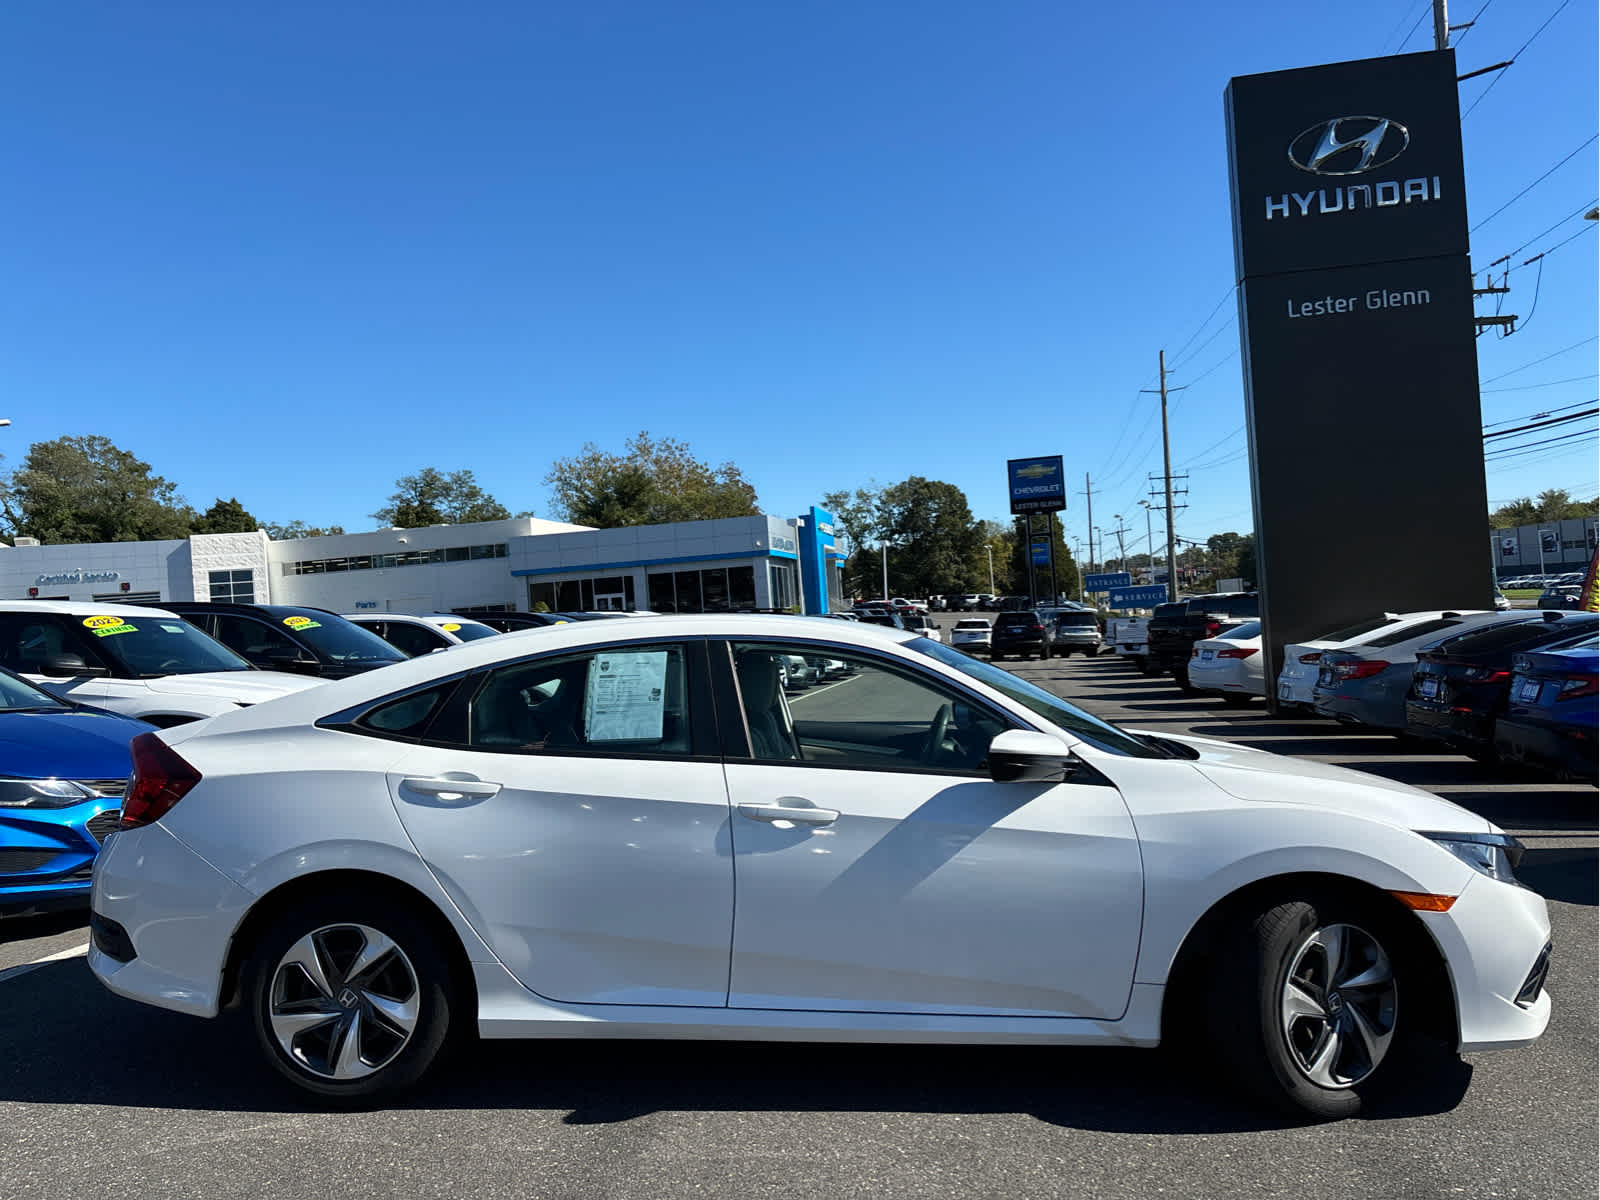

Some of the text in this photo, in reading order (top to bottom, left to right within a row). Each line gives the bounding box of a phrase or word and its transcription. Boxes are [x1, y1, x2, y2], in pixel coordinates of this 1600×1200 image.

[1265, 176, 1441, 220] HYUNDAI
[1287, 288, 1430, 318] Lester Glenn
[1014, 484, 1060, 495] CHEVROLET
[36, 571, 81, 586] Certified
[1087, 578, 1129, 586] ENTRANCE
[1125, 592, 1165, 600] SERVICE
[355, 601, 377, 609] Parts
[88, 616, 120, 627] 2023
